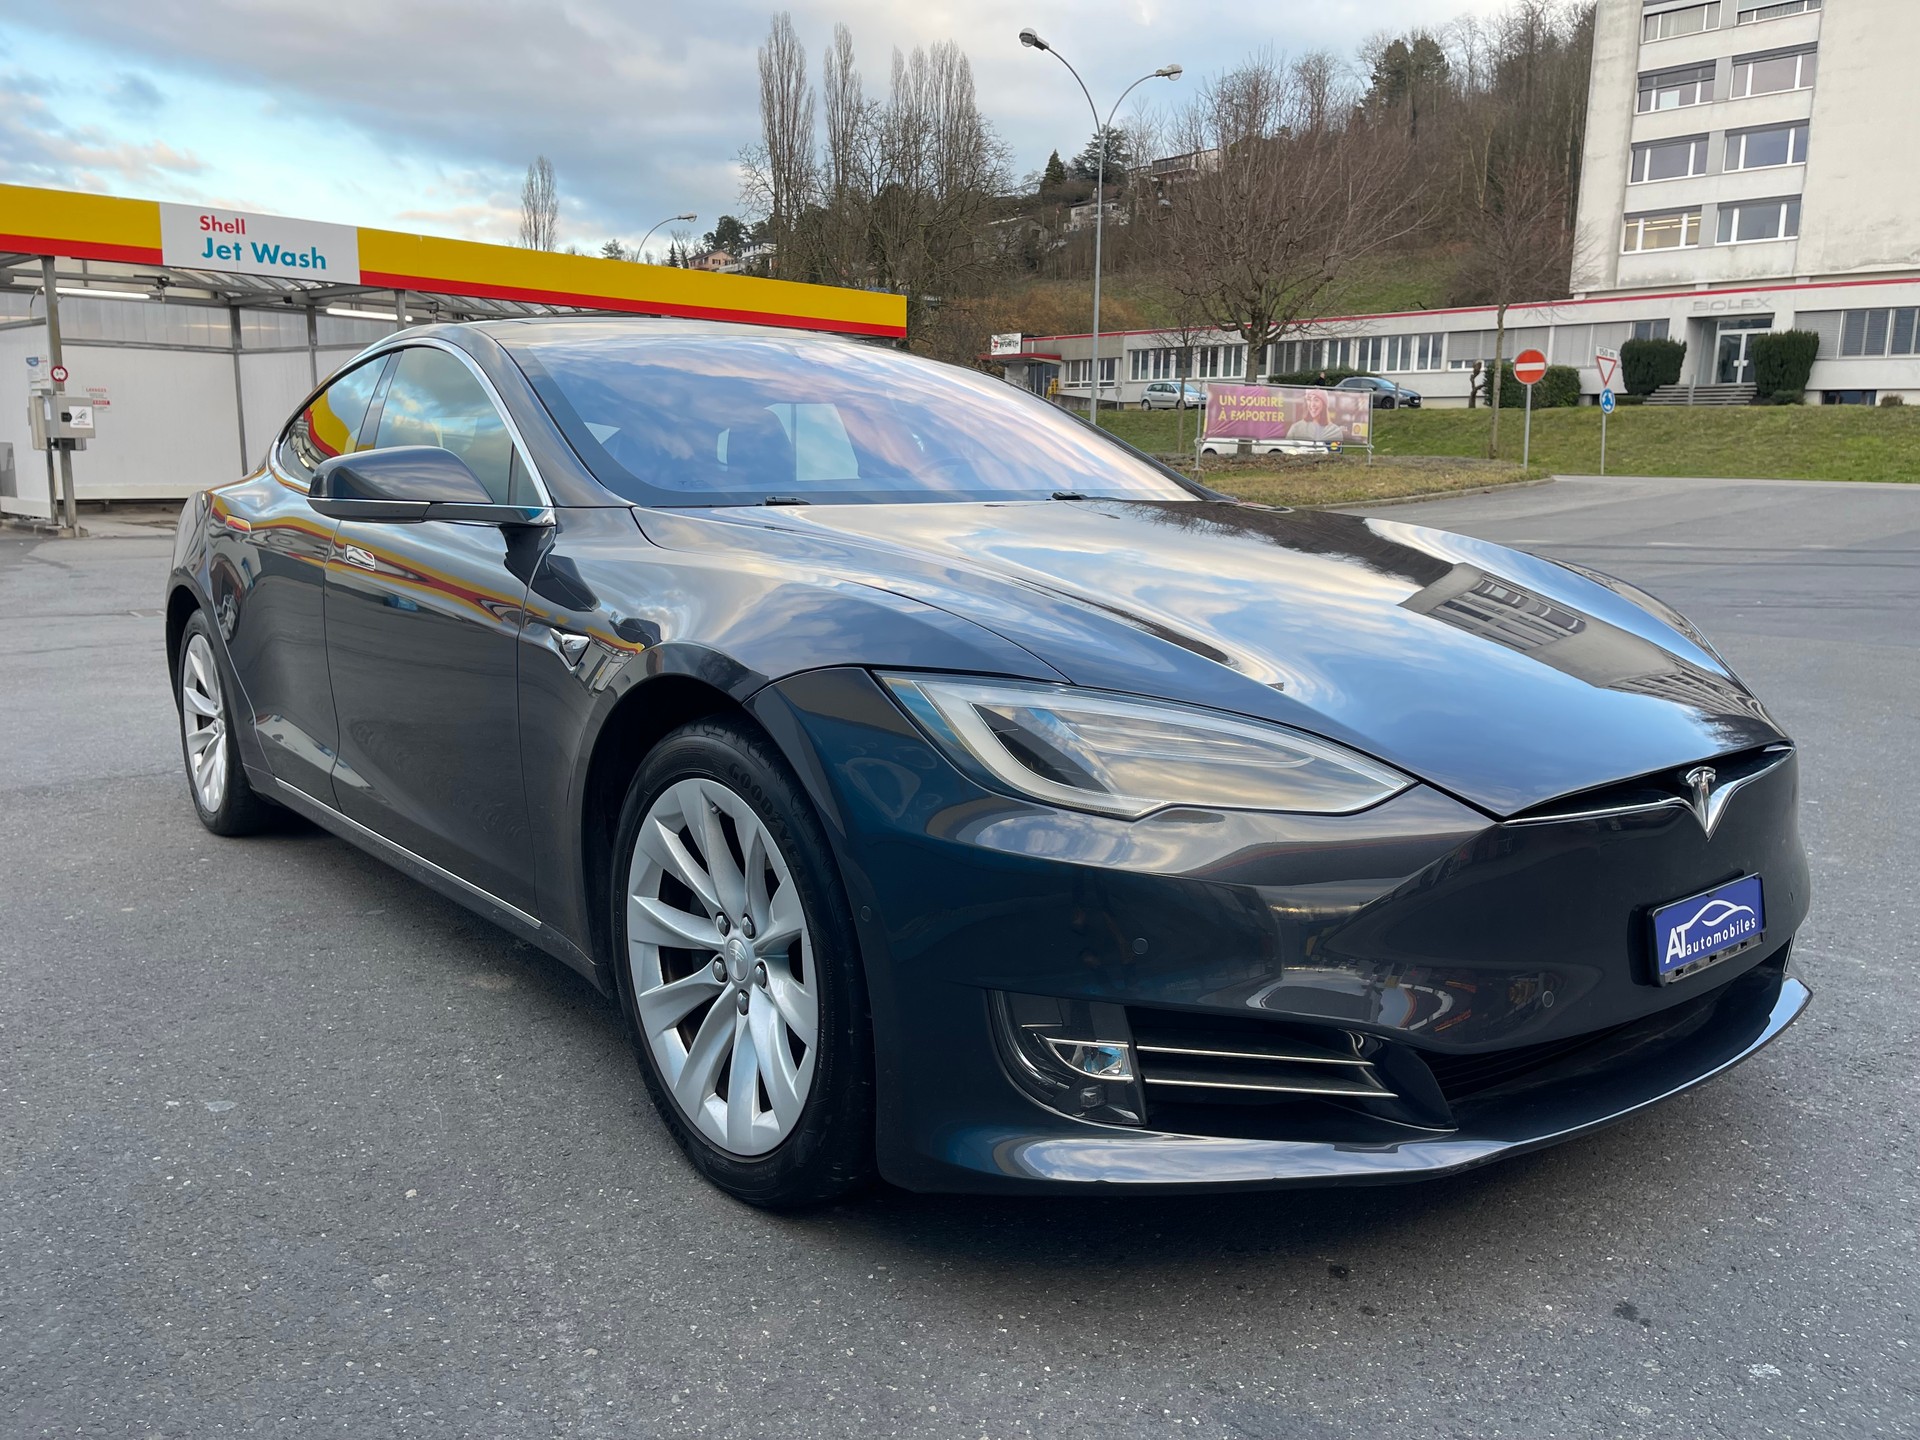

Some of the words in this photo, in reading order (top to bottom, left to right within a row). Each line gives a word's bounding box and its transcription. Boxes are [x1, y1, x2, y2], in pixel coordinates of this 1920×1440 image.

[199, 215, 246, 235] Shell
[201, 237, 242, 261] Jet
[250, 241, 327, 270] Wash
[1219, 394, 1237, 406] UN
[1240, 395, 1285, 407] SOURIRE
[1218, 407, 1227, 421] À
[1231, 410, 1285, 422] EMPORTER
[1686, 917, 1756, 956] automobiles
